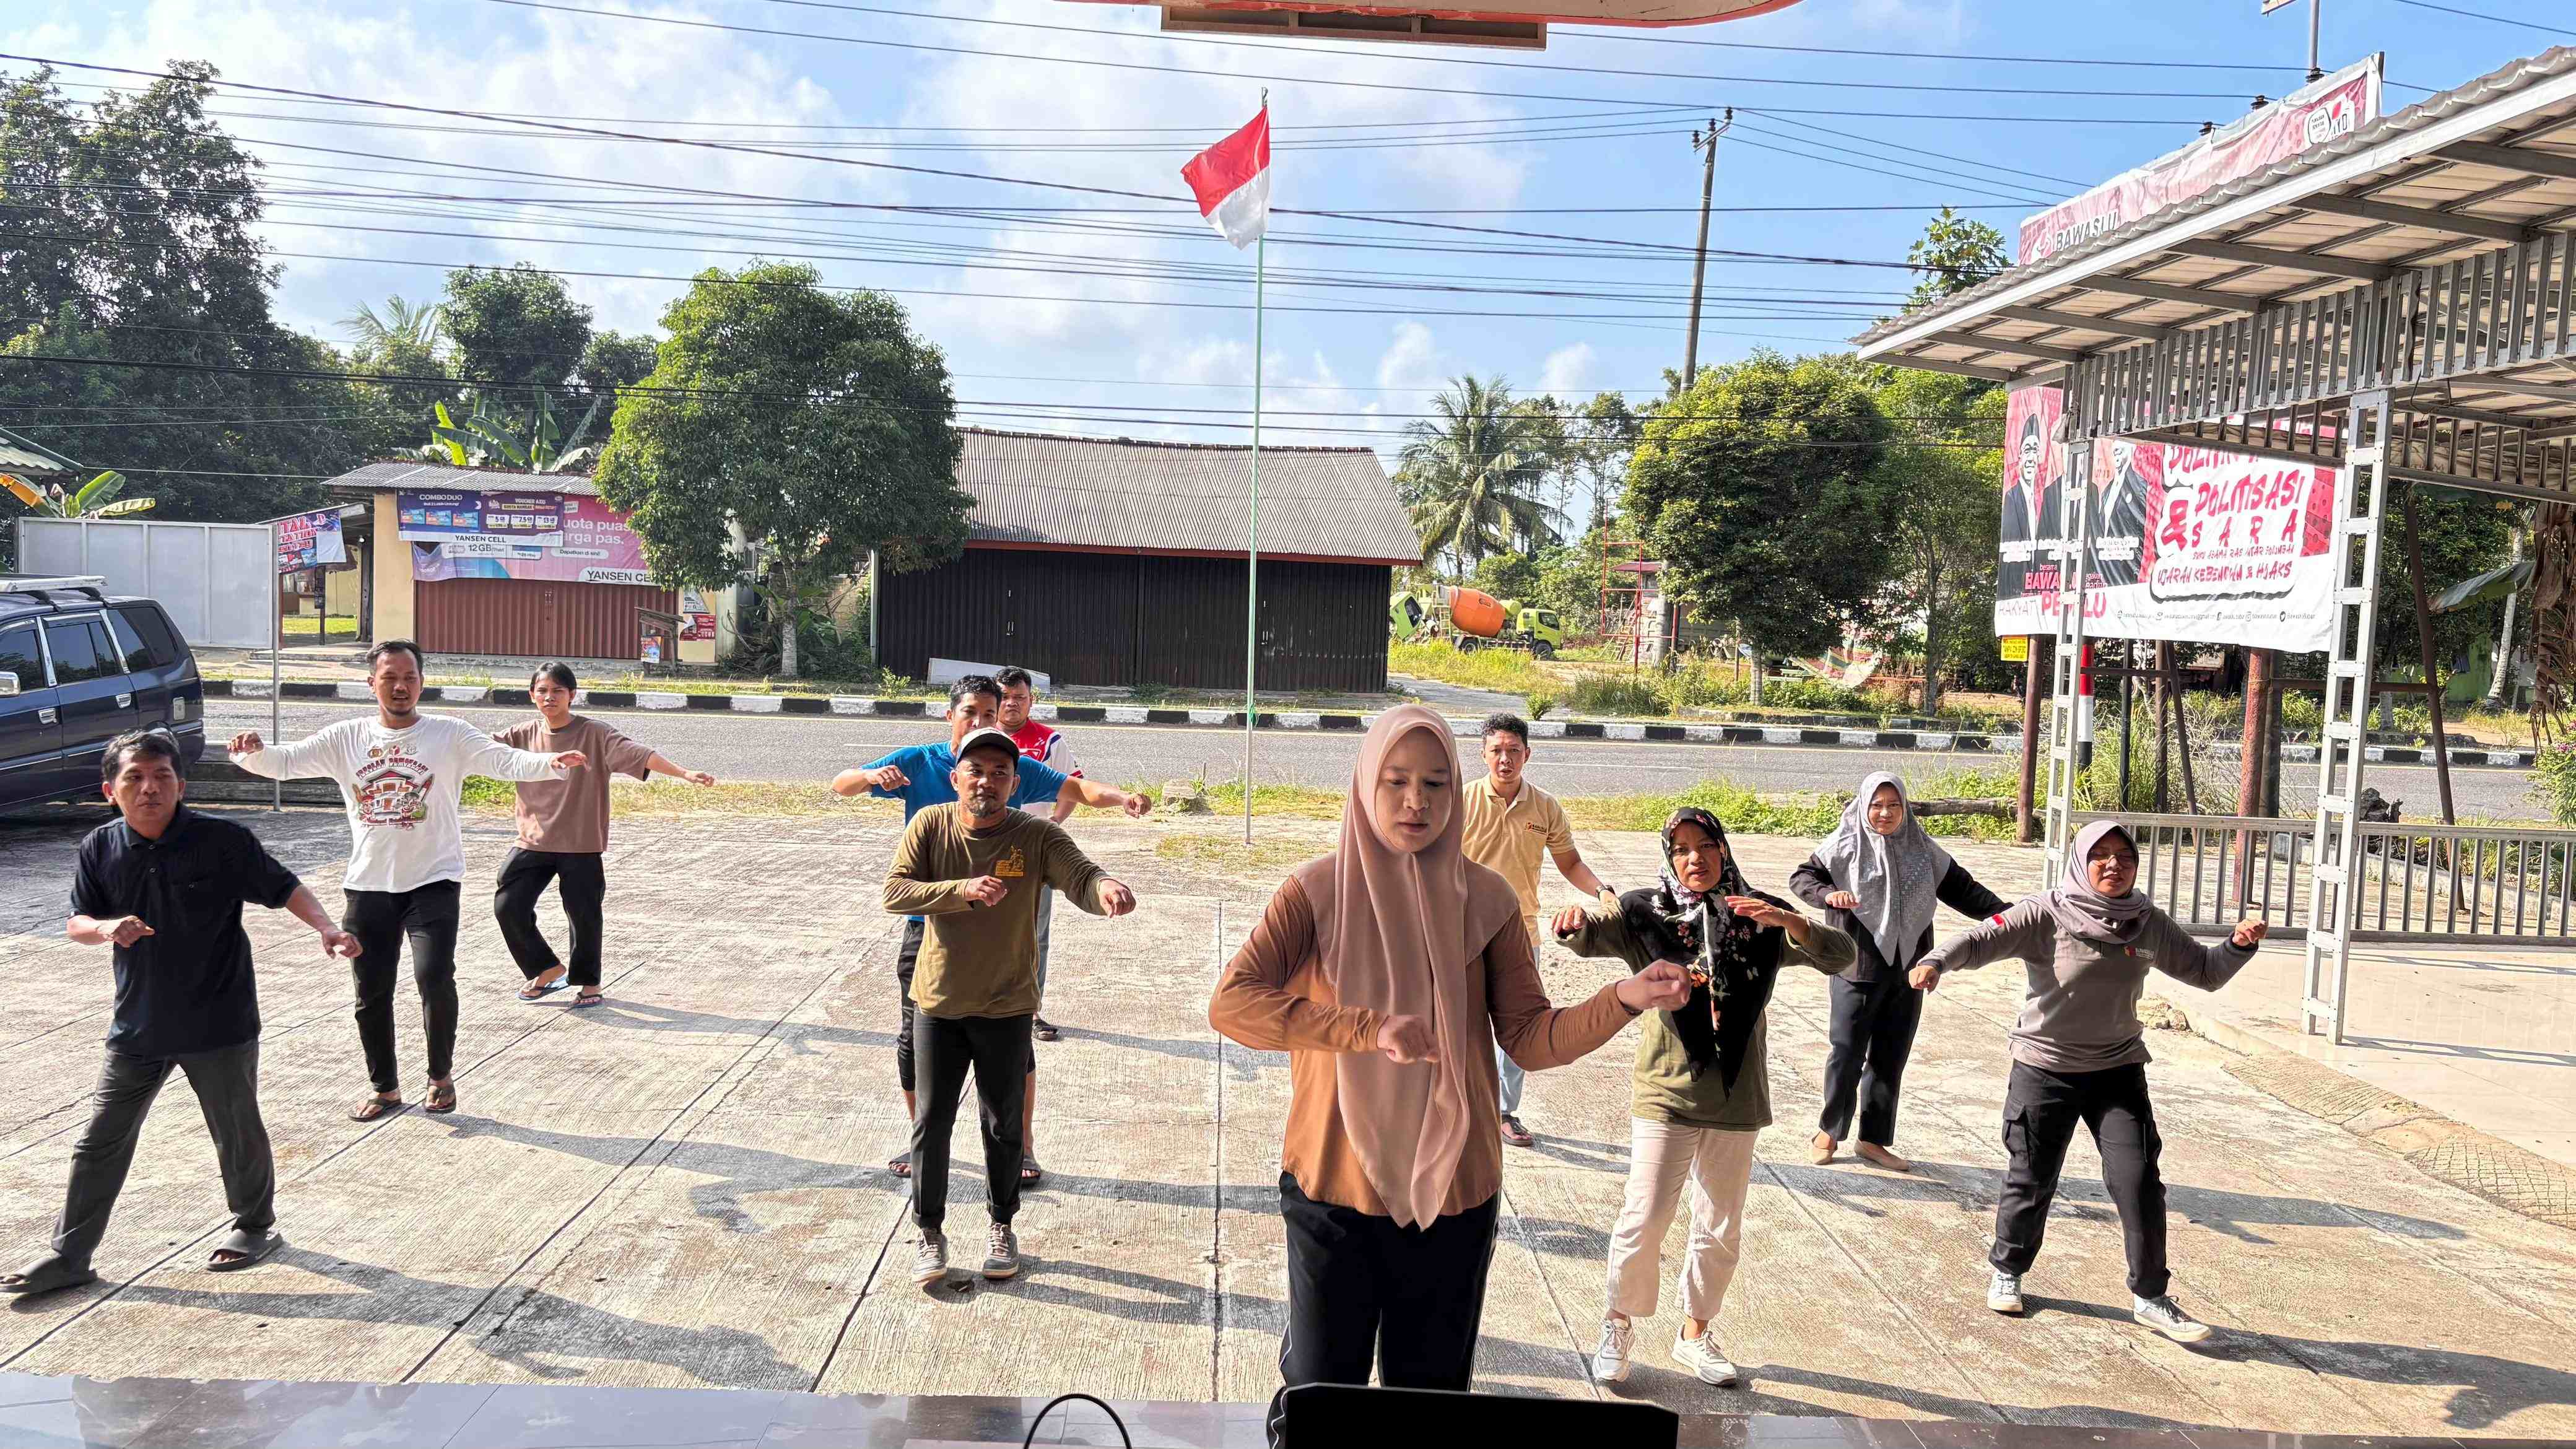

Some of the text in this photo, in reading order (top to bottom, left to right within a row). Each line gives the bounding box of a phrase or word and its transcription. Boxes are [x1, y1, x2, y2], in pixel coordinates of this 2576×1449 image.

[564, 518, 593, 529] uota
[596, 534, 624, 545] pas.
[587, 570, 651, 582] YANSEN CE
[2041, 591, 2107, 618] PELU
